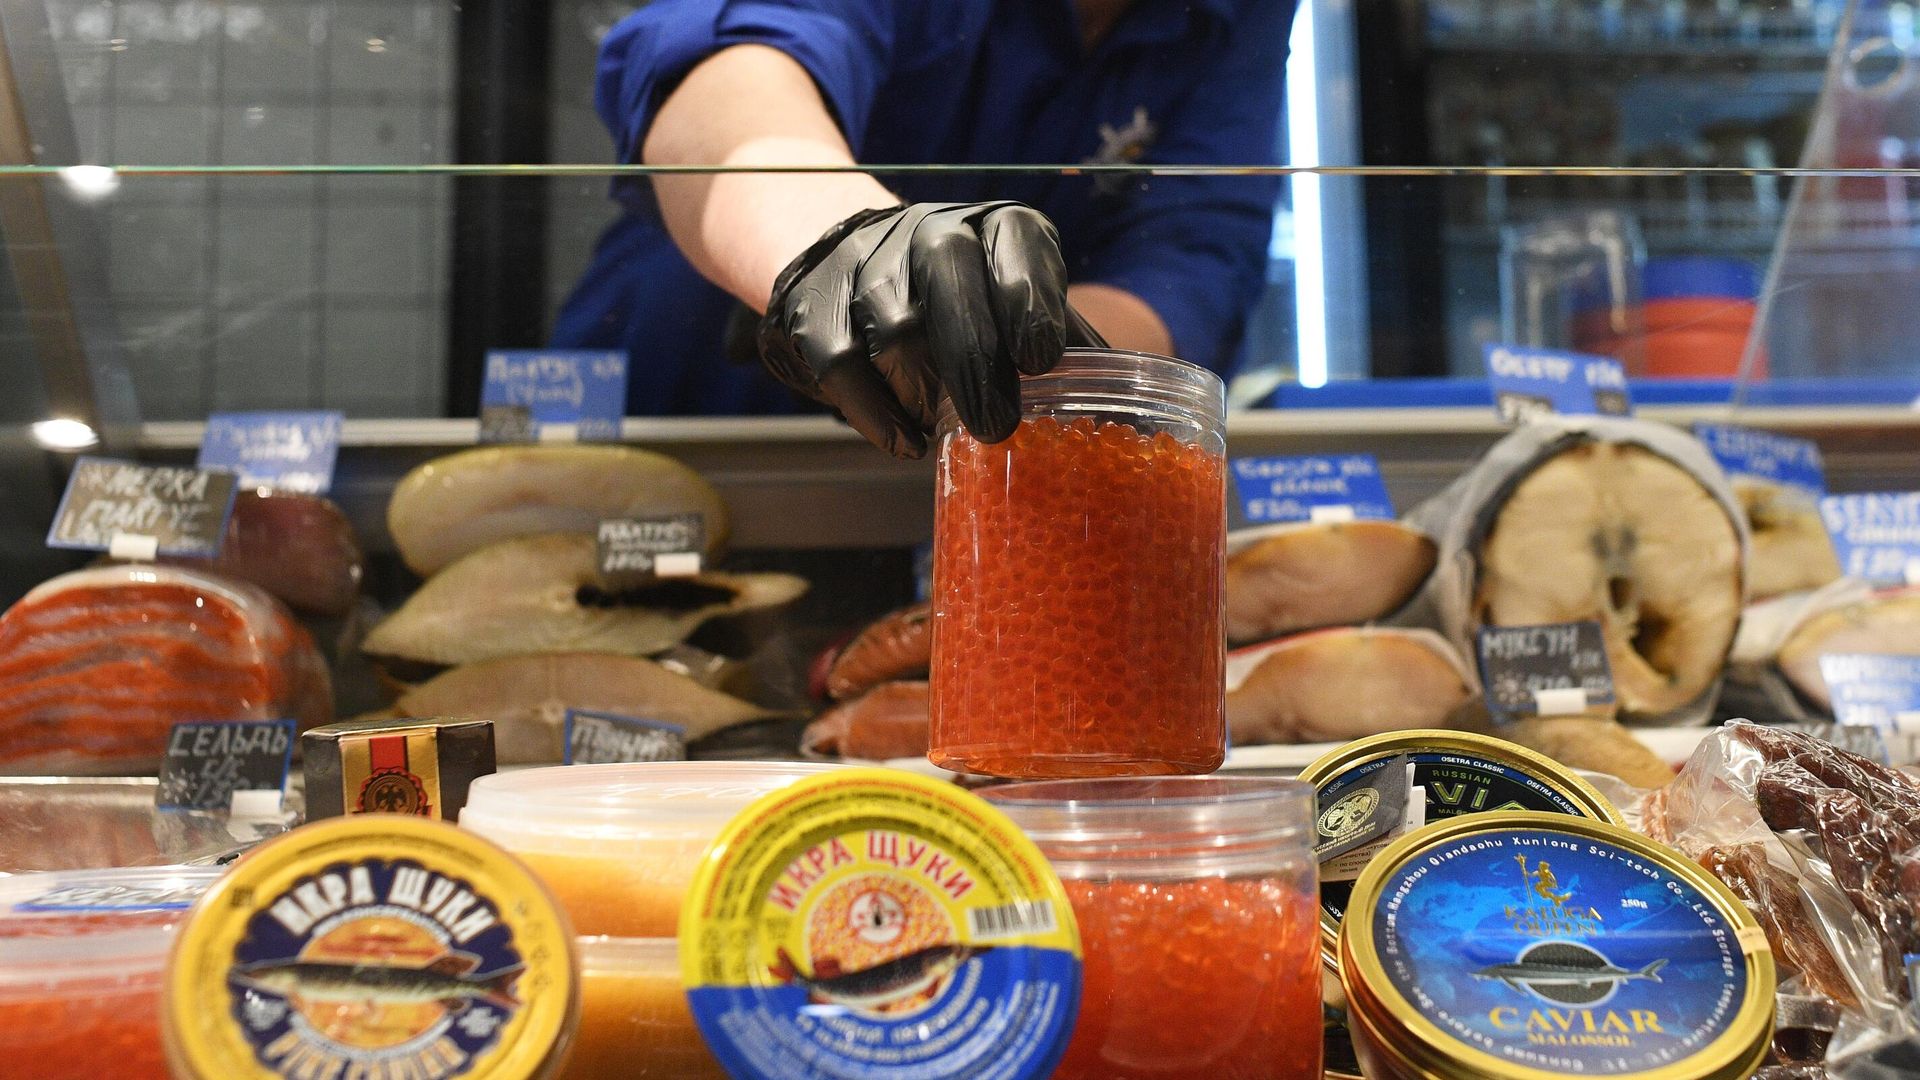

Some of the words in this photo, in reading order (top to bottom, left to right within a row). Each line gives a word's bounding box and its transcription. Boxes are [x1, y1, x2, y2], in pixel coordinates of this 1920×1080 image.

[168, 723, 289, 757] СЕЛЬДЬ
[1432, 769, 1492, 786] RUSSIAN
[1441, 756, 1471, 766] OSETRA
[1473, 760, 1506, 775] CLASSIC
[1526, 779, 1553, 797] OSETRA
[1553, 795, 1579, 817] CLASSIC
[768, 836, 855, 912] ИКРА
[867, 830, 975, 900] ЩУКИ
[1429, 839, 1503, 866] Qiandaohu
[1512, 836, 1579, 851] Xunlong
[1589, 845, 1660, 880] Sci-tech
[269, 866, 376, 937] ИКРА
[1711, 929, 1735, 977] Storage
[1488, 1006, 1664, 1035] CAVIAR
